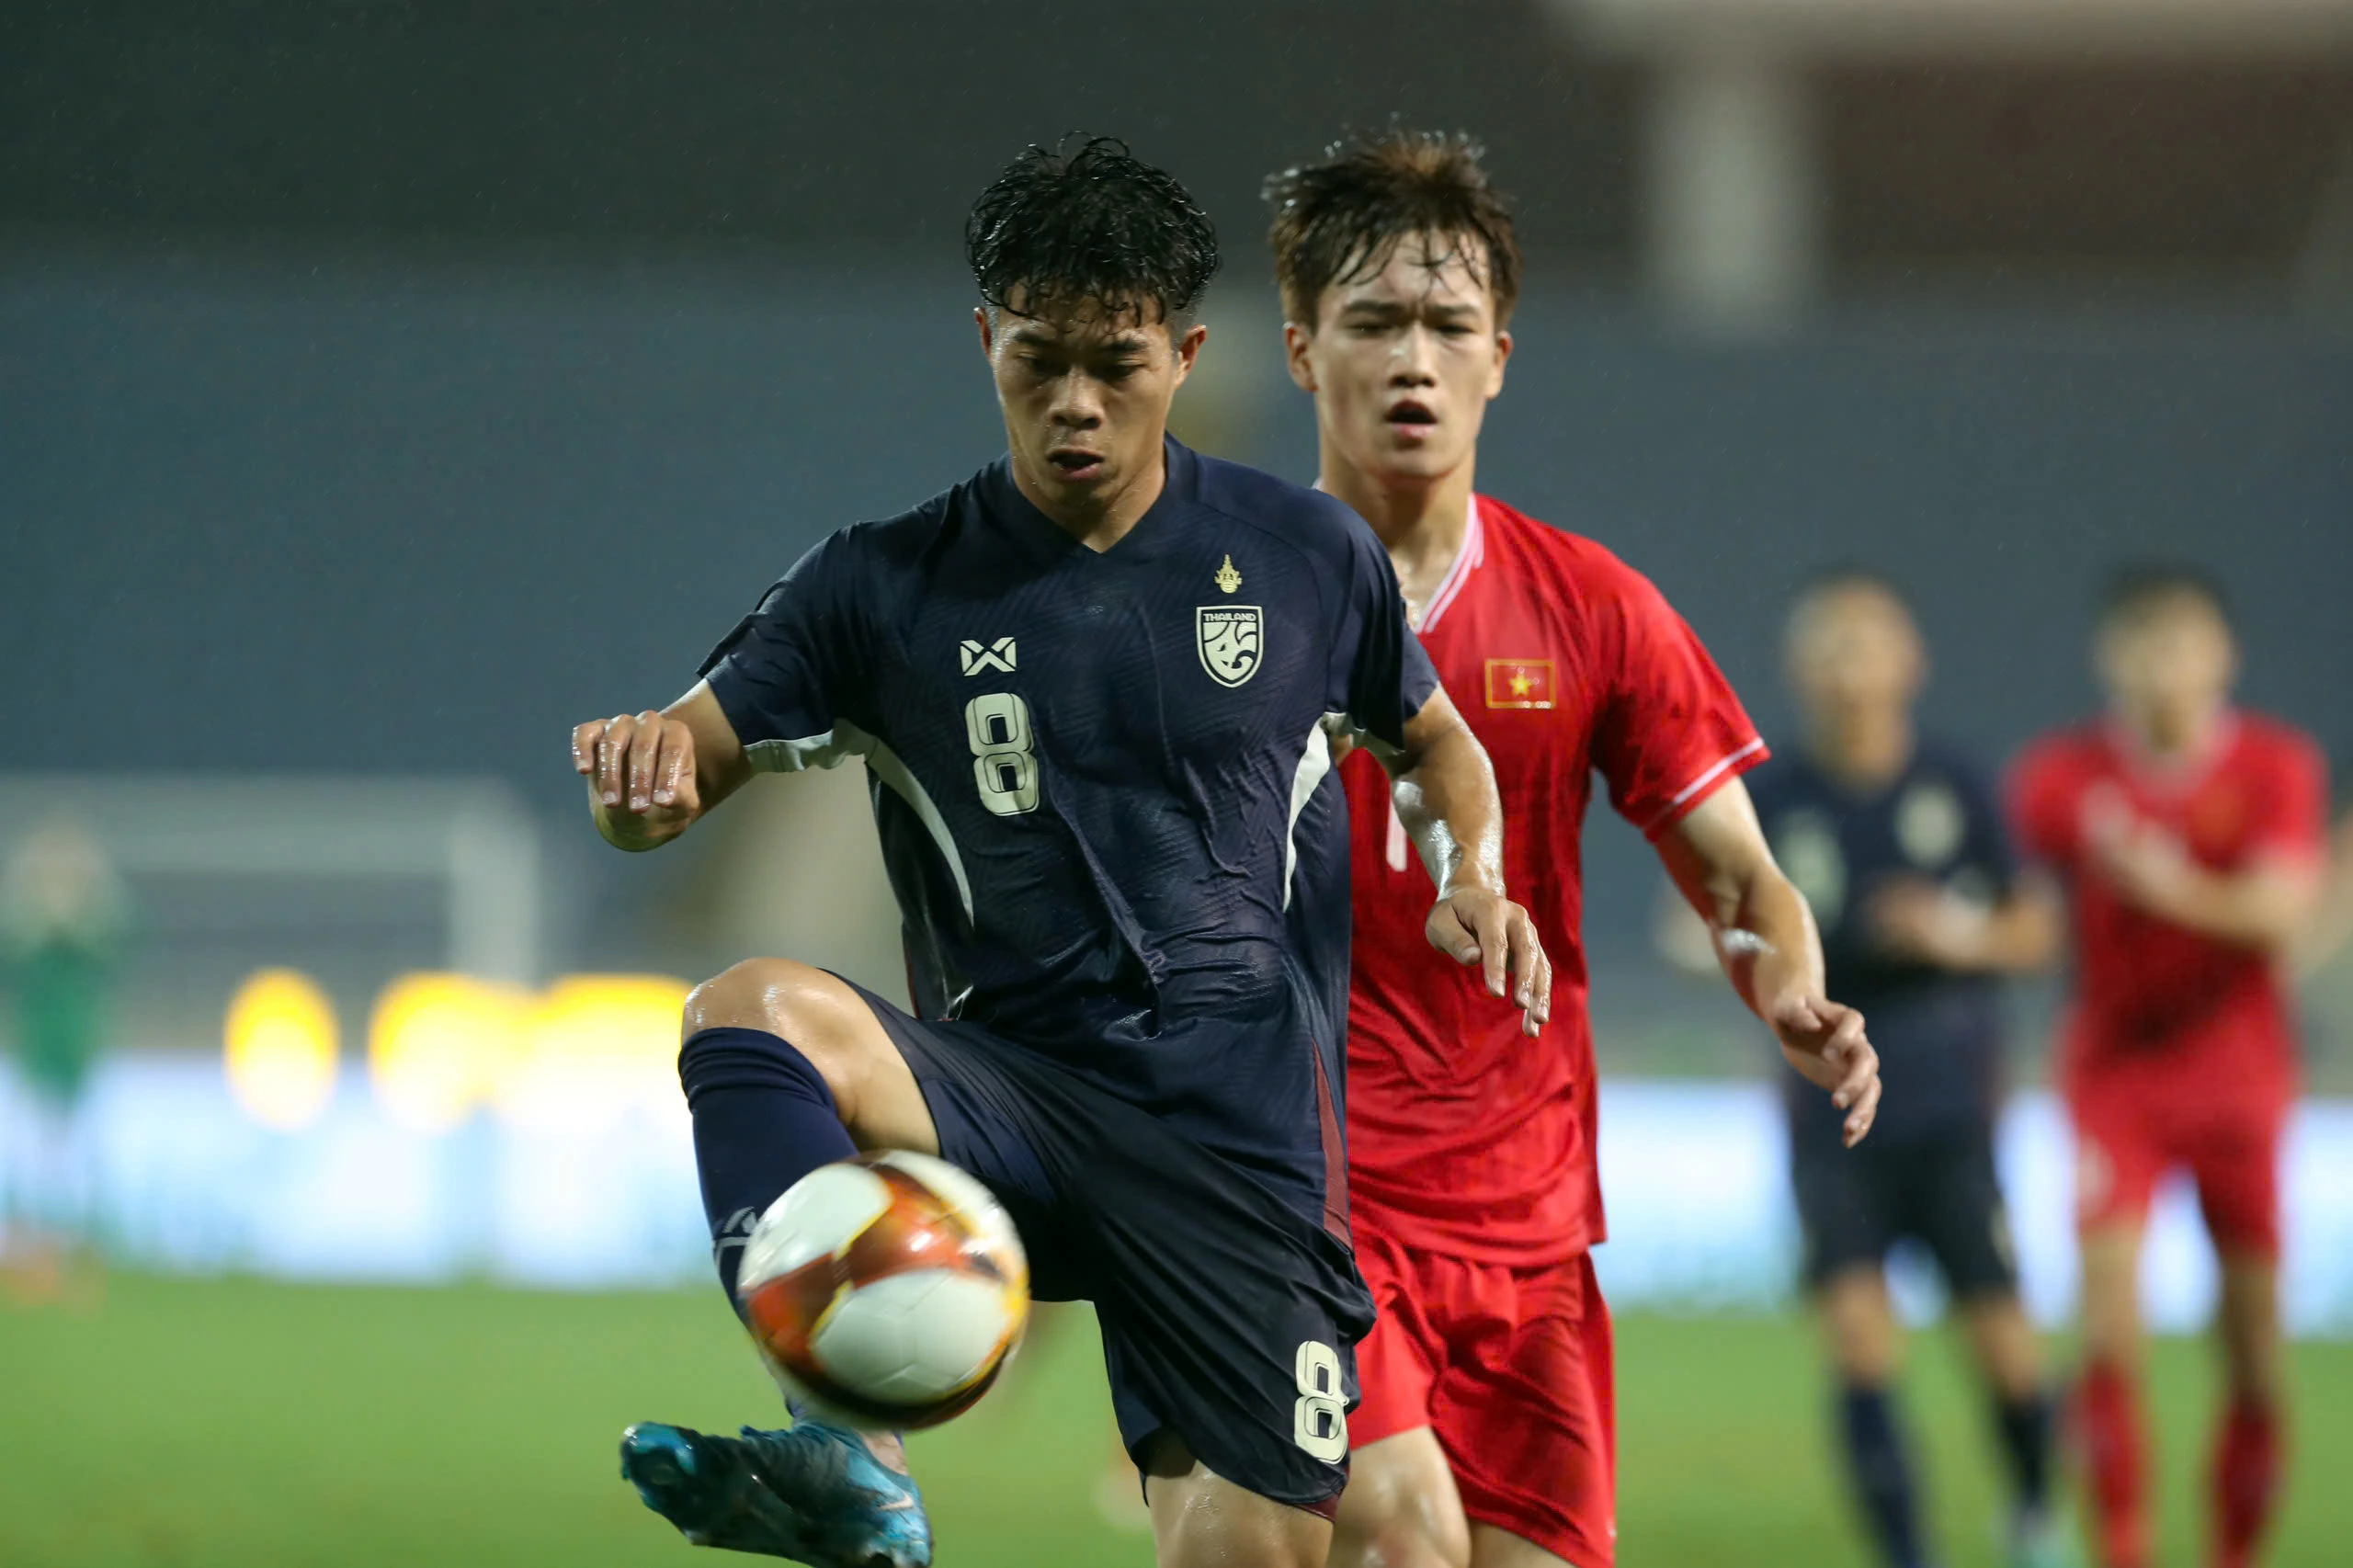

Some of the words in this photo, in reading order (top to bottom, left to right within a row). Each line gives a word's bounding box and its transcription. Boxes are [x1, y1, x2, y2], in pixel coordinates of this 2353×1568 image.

[1203, 613, 1256, 622] THAILAND
[966, 693, 1040, 816] 8
[1294, 1341, 1349, 1465] 8
